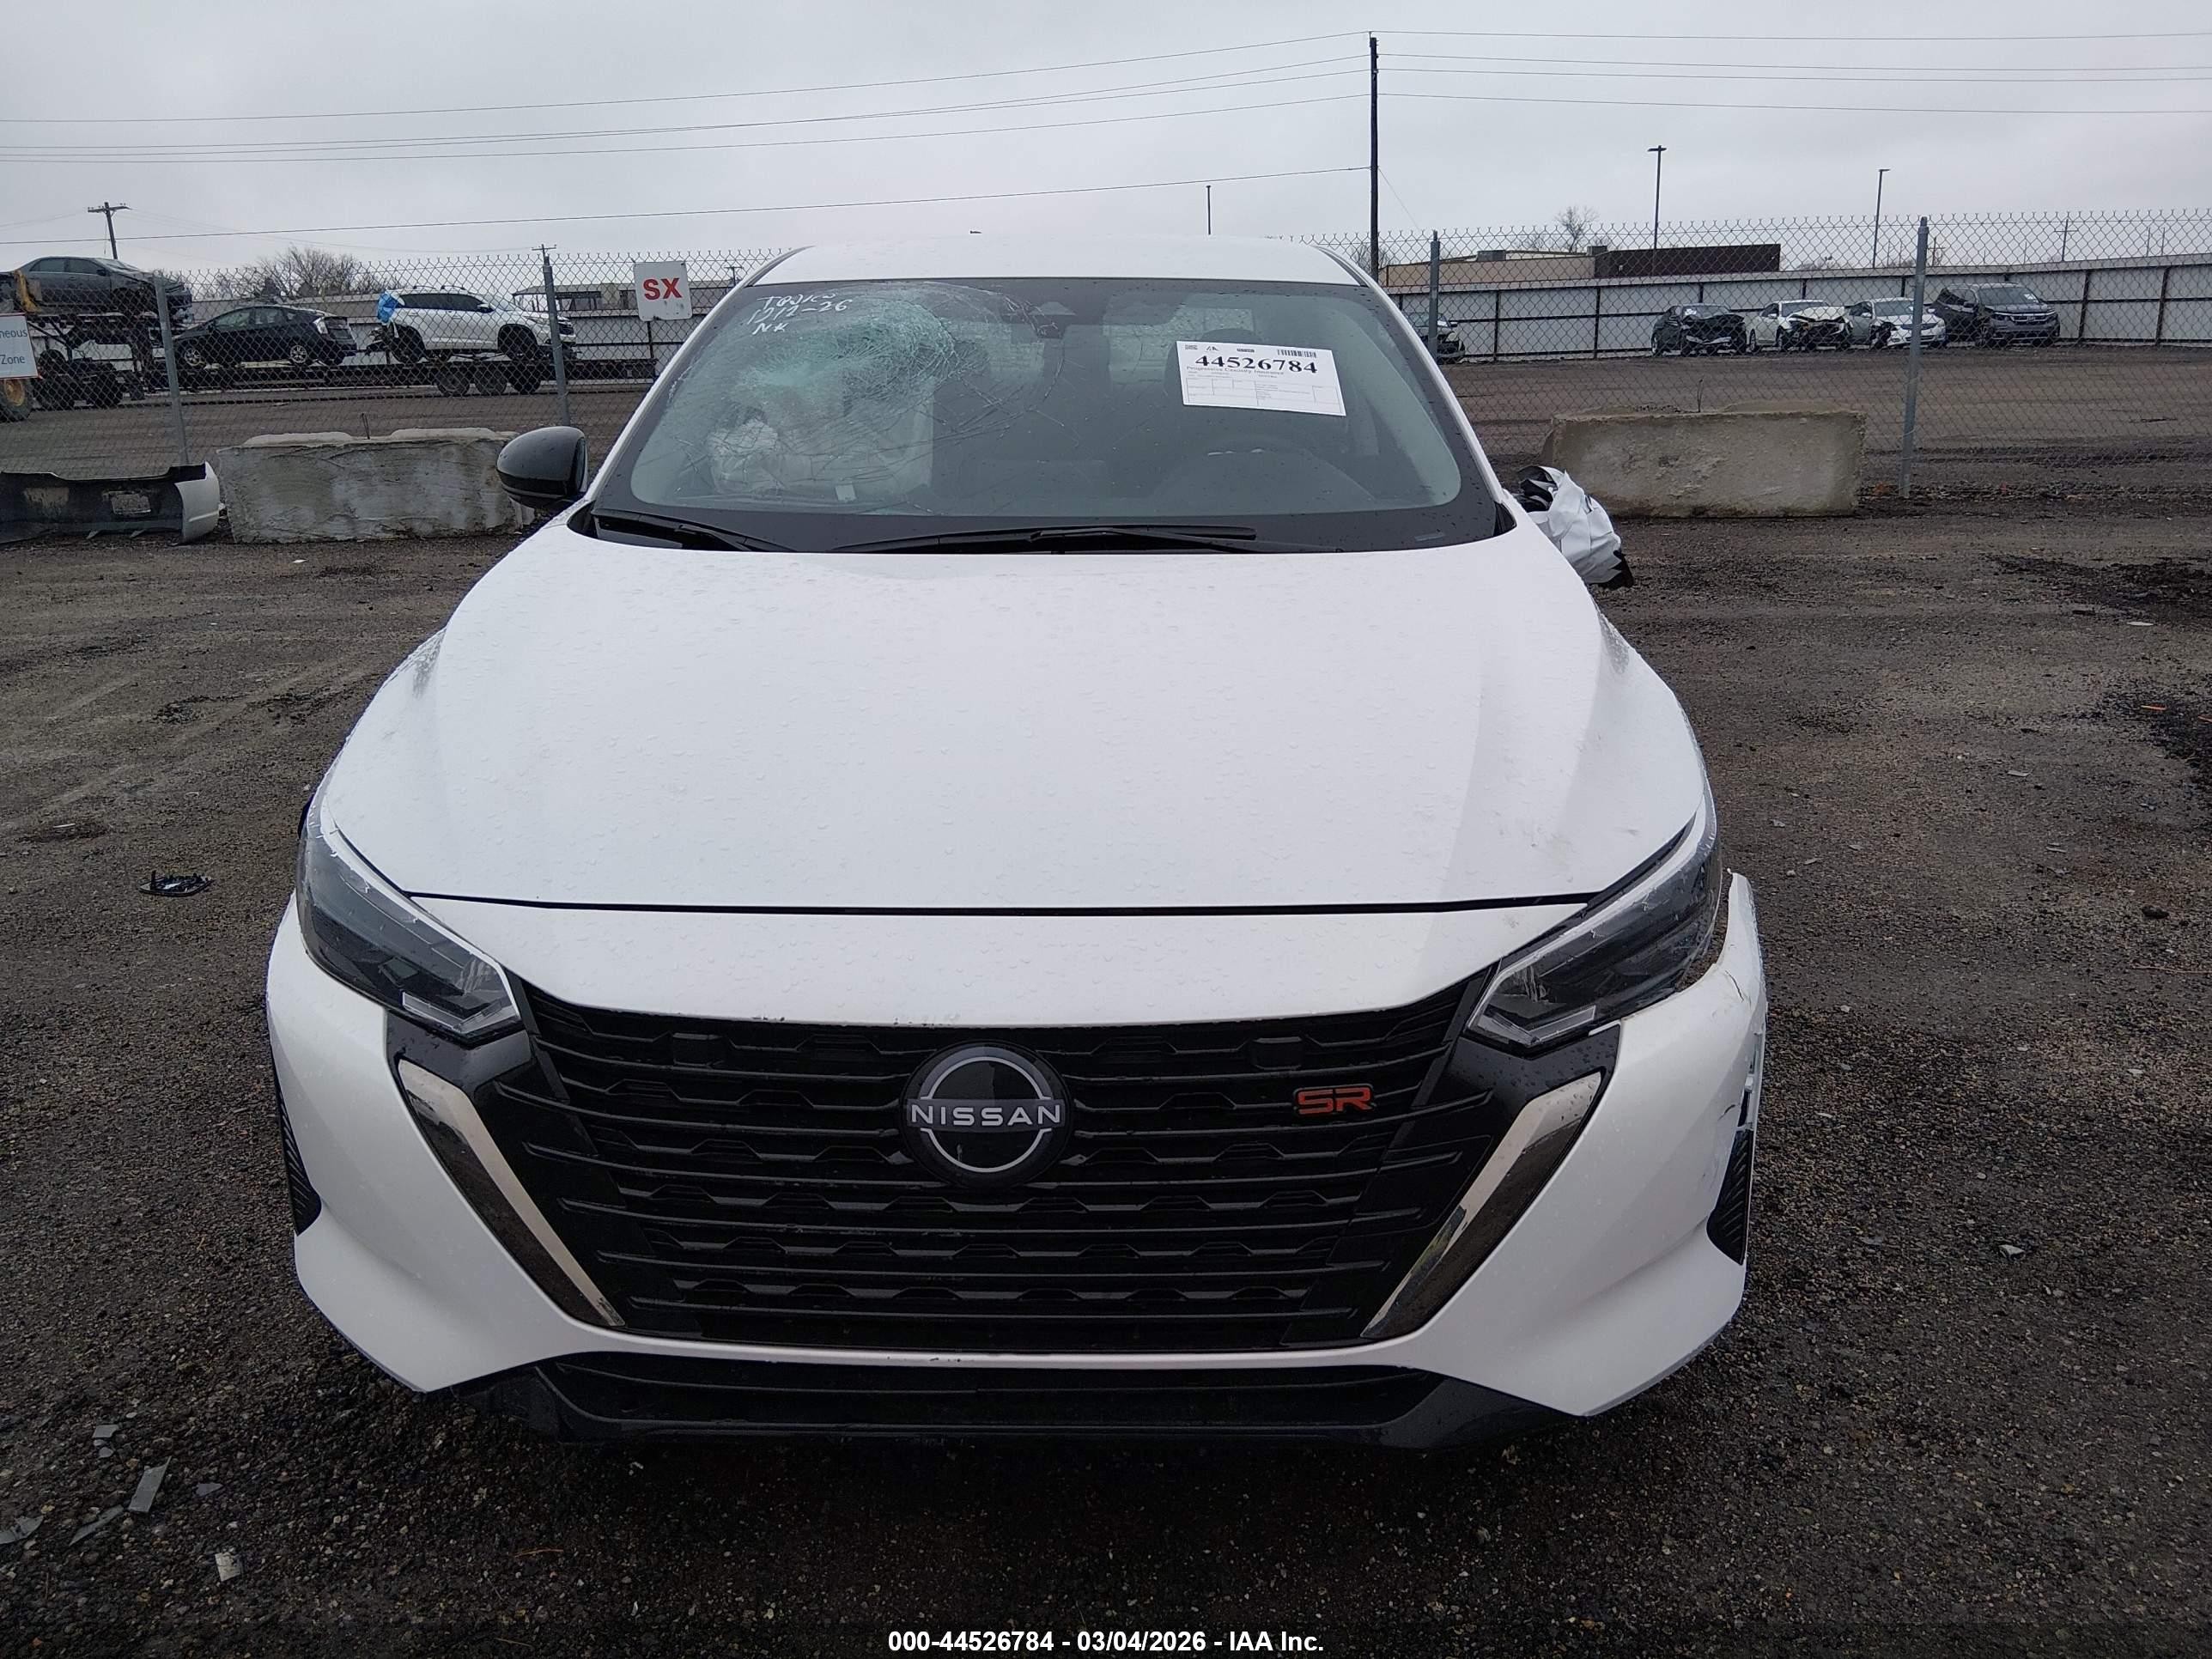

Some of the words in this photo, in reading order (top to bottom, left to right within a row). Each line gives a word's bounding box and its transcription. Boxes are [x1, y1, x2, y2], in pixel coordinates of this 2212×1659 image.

[643, 278, 683, 300] SX
[0, 354, 26, 365] Zone
[1195, 355, 1318, 374] 44526784
[1297, 1086, 1374, 1115] SR
[911, 1104, 1060, 1126] NISSAN
